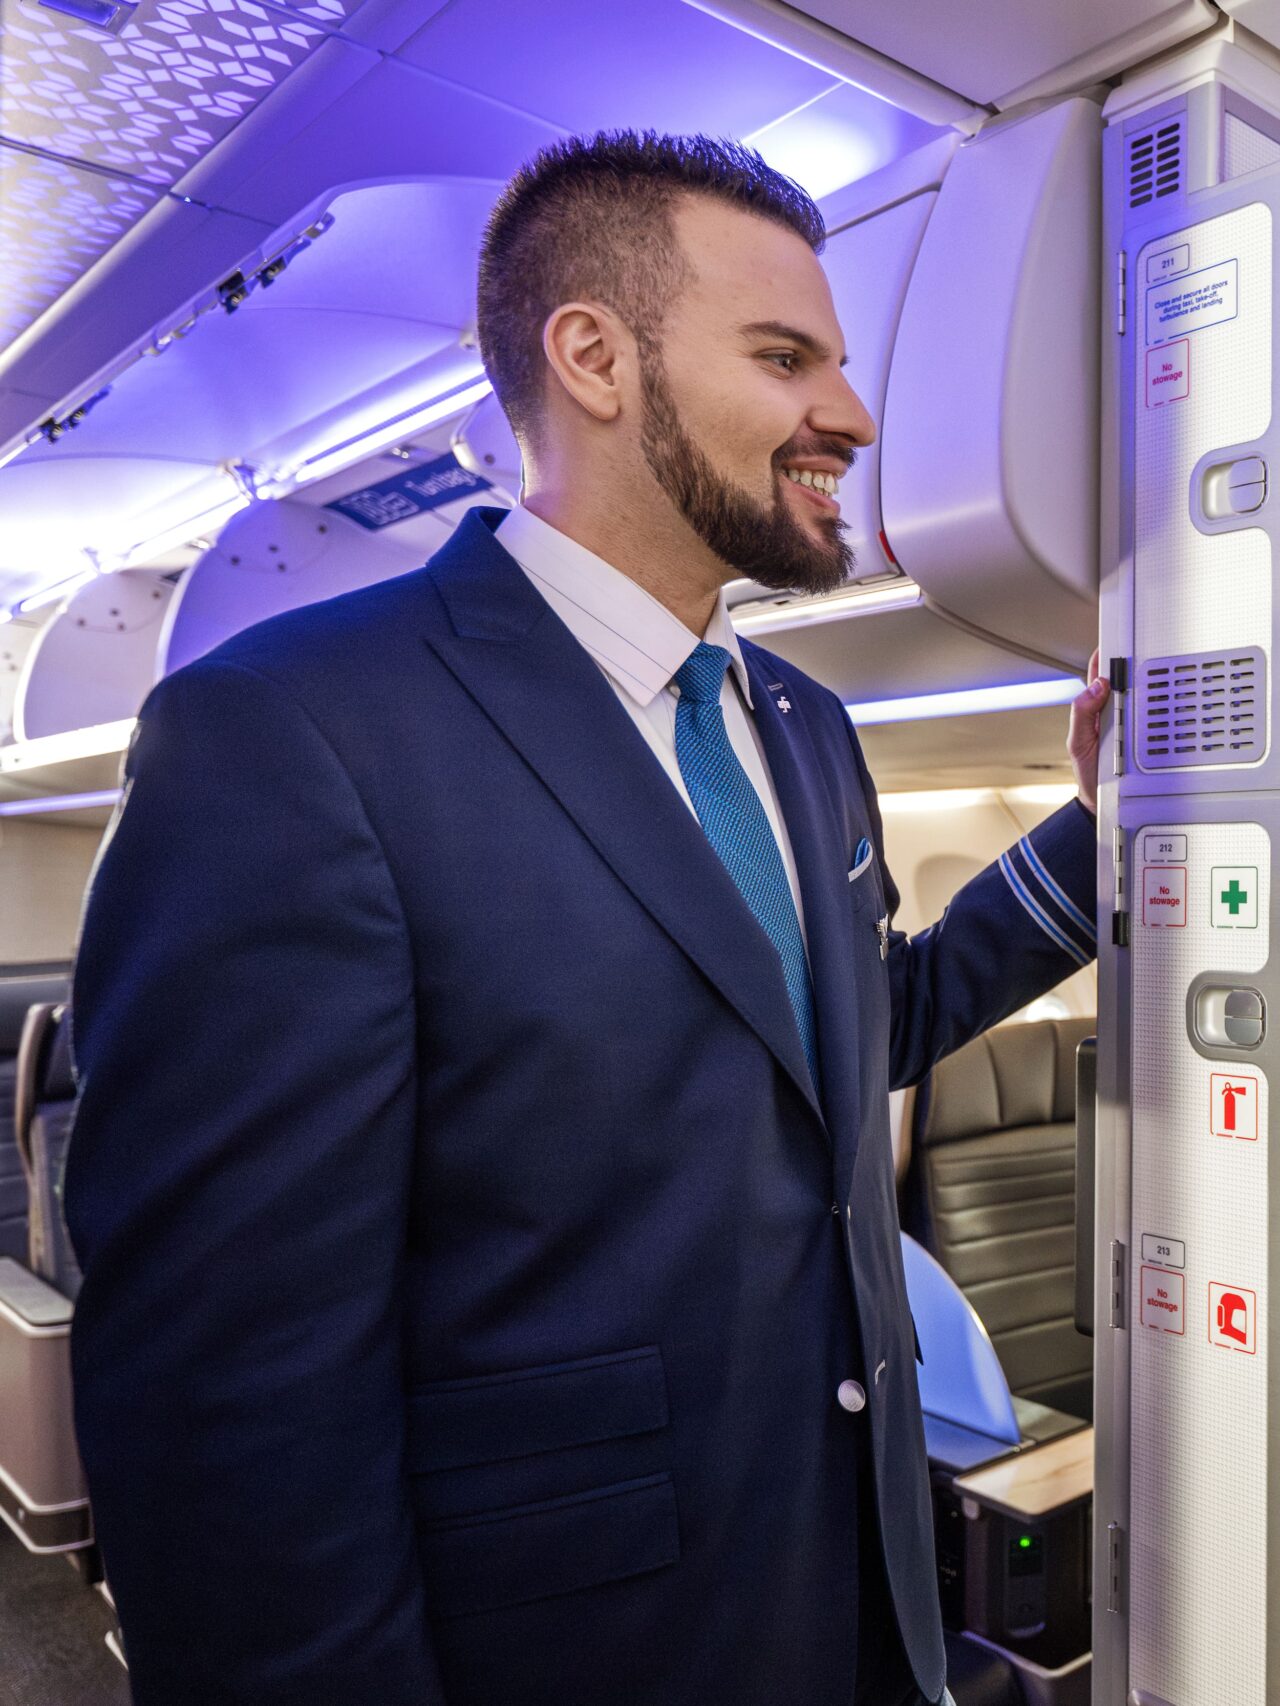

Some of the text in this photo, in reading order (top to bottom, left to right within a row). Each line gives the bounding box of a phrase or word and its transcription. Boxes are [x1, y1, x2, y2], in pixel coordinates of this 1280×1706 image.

[1161, 257, 1174, 269] 211
[1154, 299, 1171, 310] Close
[1171, 294, 1182, 303] and
[1183, 287, 1202, 300] secure
[1211, 280, 1228, 291] doors
[1159, 297, 1223, 322] turbulence and landing
[1163, 302, 1182, 314] during
[1162, 363, 1172, 372] No
[1152, 371, 1183, 385] stowage
[1159, 844, 1173, 852] 212
[1159, 886, 1170, 895] No
[1149, 897, 1180, 907] stowage
[1157, 1245, 1170, 1256] 213
[1157, 1288, 1168, 1299] No
[1147, 1298, 1178, 1312] stowage
